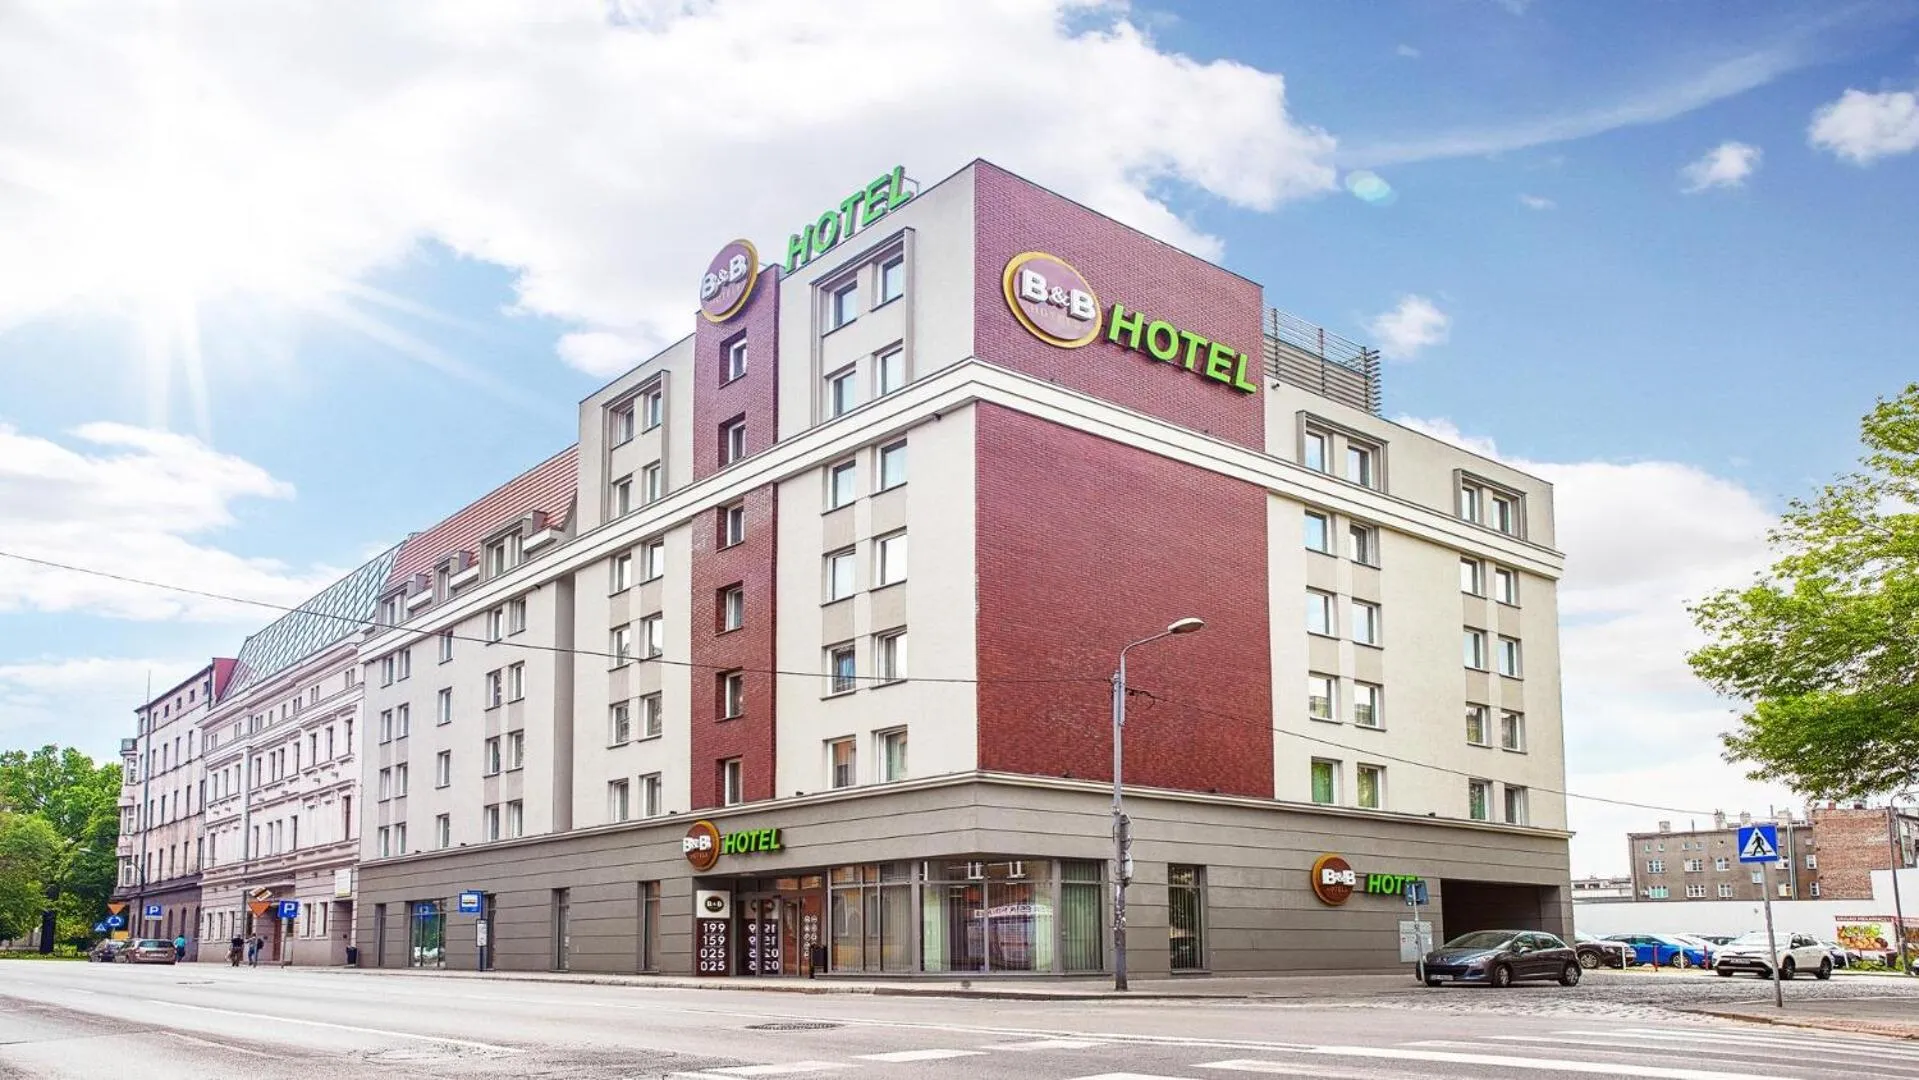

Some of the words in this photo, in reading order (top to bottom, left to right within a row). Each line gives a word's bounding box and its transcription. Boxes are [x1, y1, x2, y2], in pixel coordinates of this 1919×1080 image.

[785, 165, 913, 274] HOTEL
[701, 254, 747, 300] B&B
[1020, 269, 1096, 321] B&B
[1108, 303, 1257, 394] HOTEL
[683, 835, 711, 853] B&B
[725, 829, 780, 854] HOTEL
[1322, 869, 1356, 885] B&B
[1368, 873, 1419, 895] HOT
[149, 906, 159, 915] P
[284, 903, 295, 913] P
[703, 923, 726, 933] 199
[703, 935, 725, 945] 159
[700, 948, 725, 958] 025
[700, 960, 725, 971] 025
